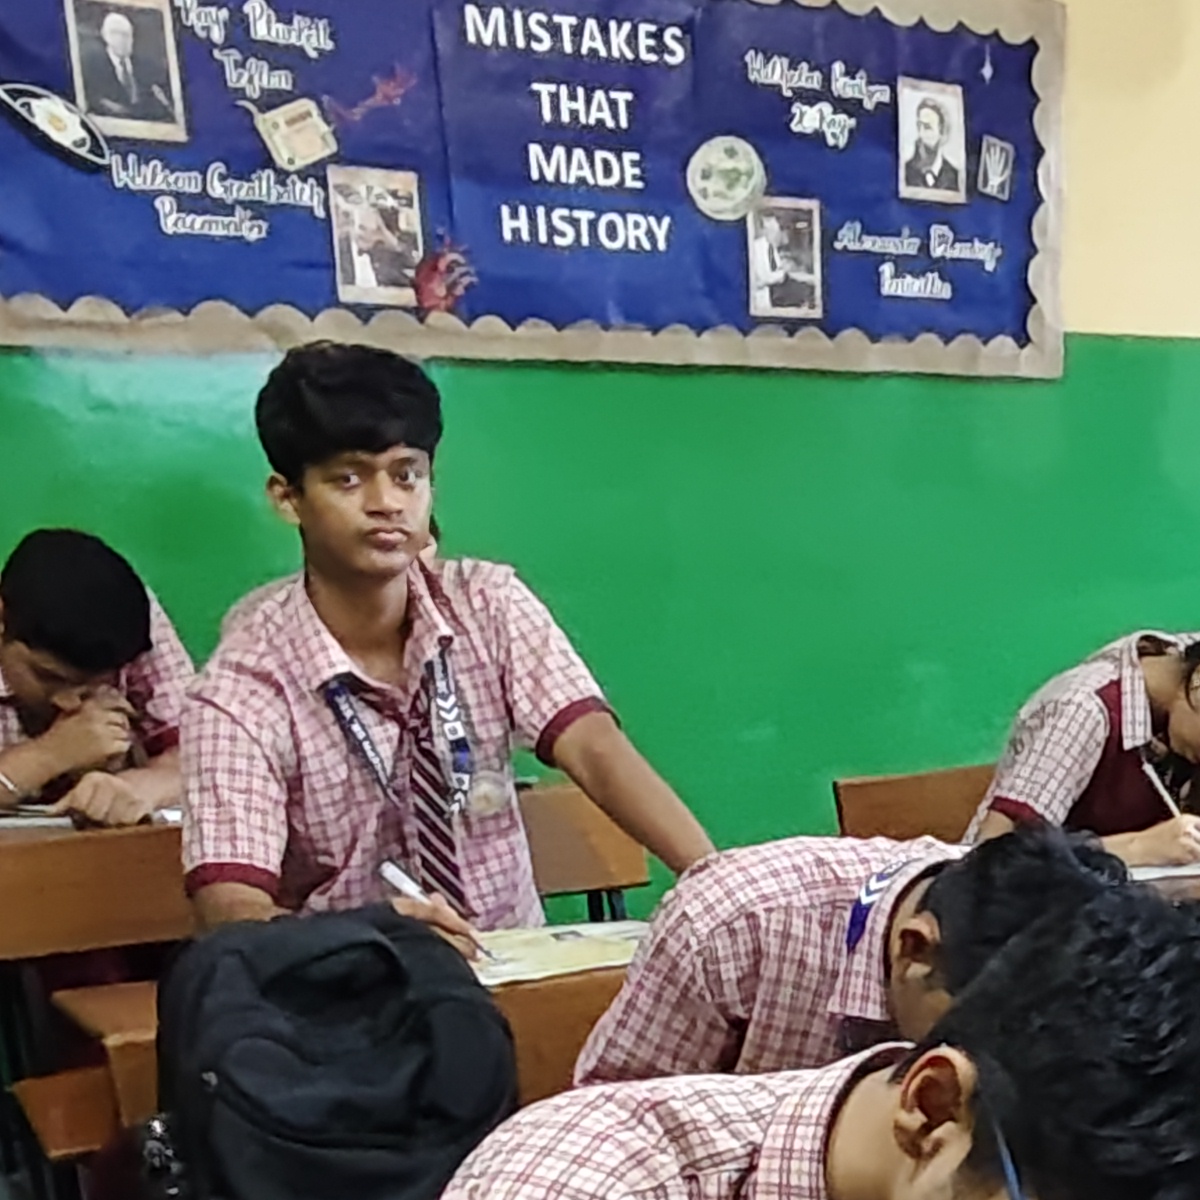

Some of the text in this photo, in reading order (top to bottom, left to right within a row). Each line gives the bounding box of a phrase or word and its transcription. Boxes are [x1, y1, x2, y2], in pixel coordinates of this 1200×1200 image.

[464, 3, 685, 66] MISTAKES
[530, 82, 634, 130] THAT
[527, 142, 645, 190] MADE
[500, 203, 671, 252] HISTORY
